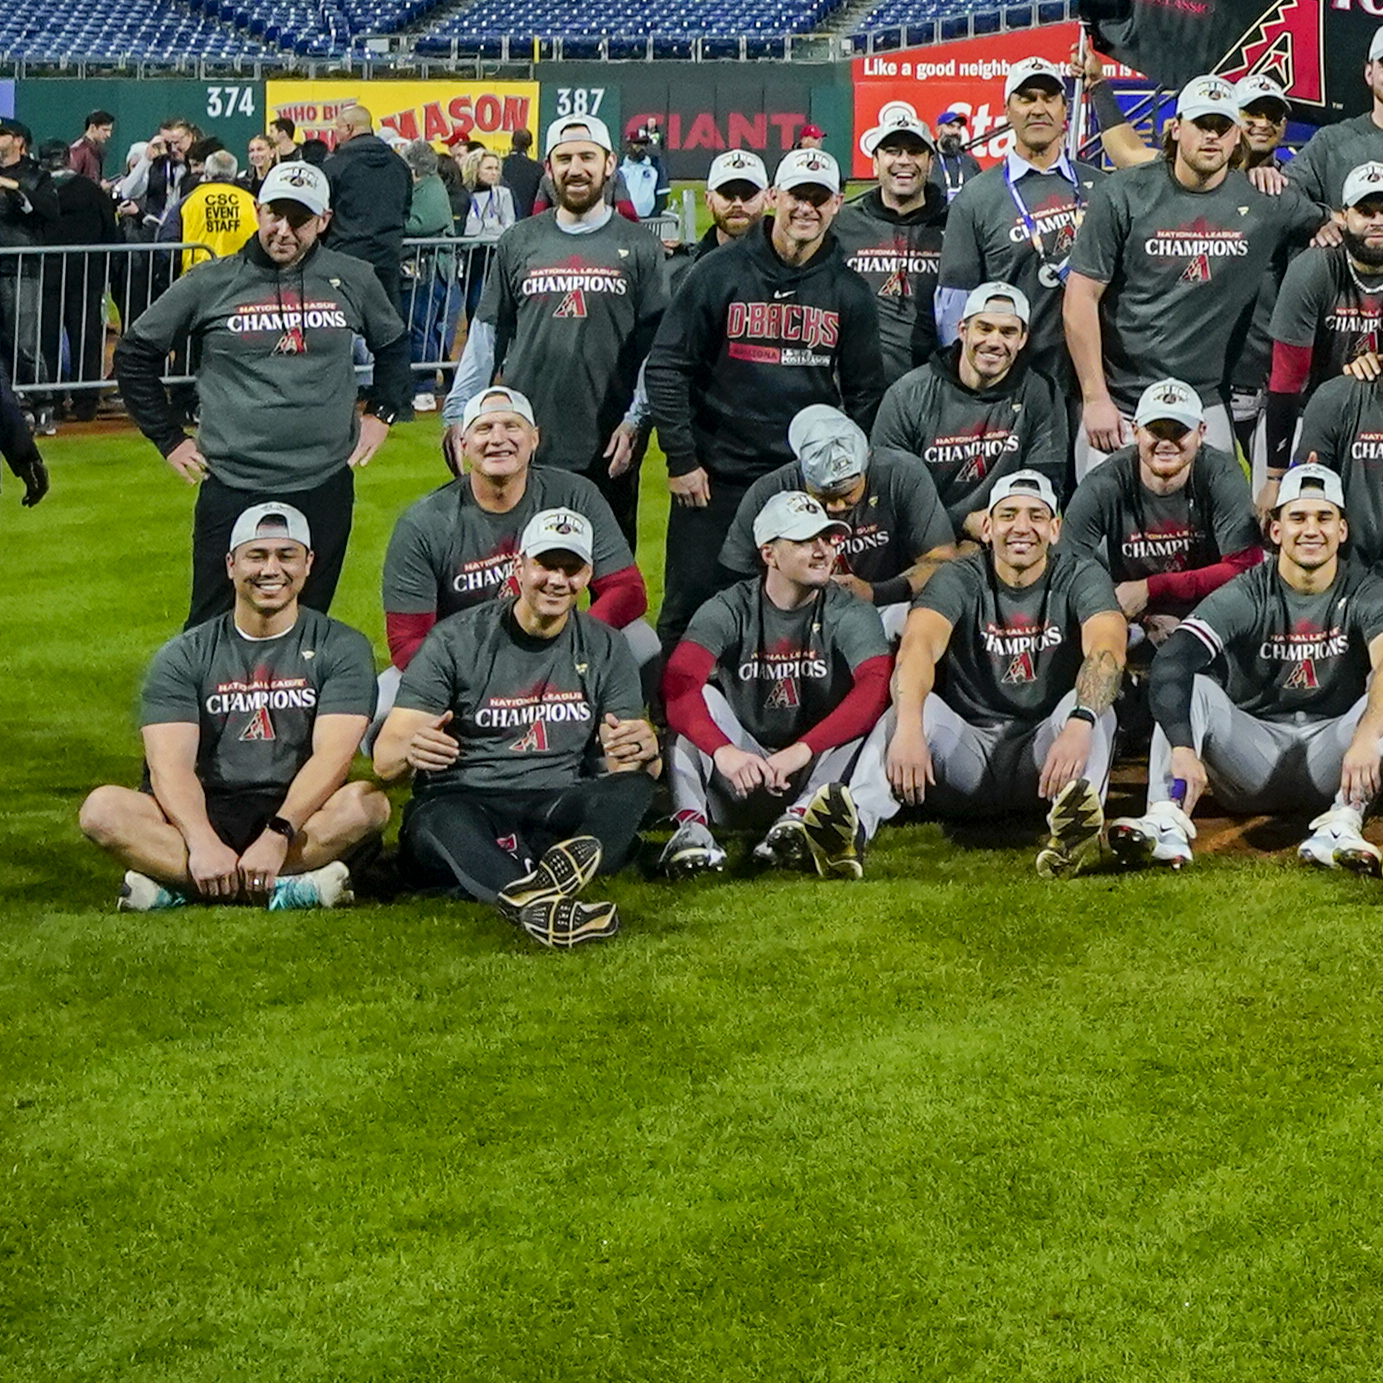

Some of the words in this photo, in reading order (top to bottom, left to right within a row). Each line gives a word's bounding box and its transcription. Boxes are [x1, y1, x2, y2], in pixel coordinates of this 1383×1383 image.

[864, 57, 897, 75] Like
[901, 63, 912, 76] a
[917, 57, 955, 79] good
[959, 59, 1010, 79] neighb
[206, 86, 255, 117] 374
[556, 87, 606, 117] 387
[277, 105, 317, 123] WHO
[380, 94, 531, 141] MASON
[205, 194, 239, 205] CSC
[205, 207, 240, 219] EVENT
[206, 220, 241, 233] STAFF
[1156, 230, 1199, 239] NATIONAL
[1201, 230, 1243, 239] LEAGUE
[1145, 238, 1249, 258] CHAMPIONS
[530, 267, 578, 277] NATIONAL
[580, 267, 622, 277] LEAGUE
[522, 276, 627, 296] CHAMPIONS
[226, 311, 347, 333] CHAMPIONS
[205, 688, 317, 715] CHAMPIONS
[475, 701, 591, 728] CHAMPIONS
